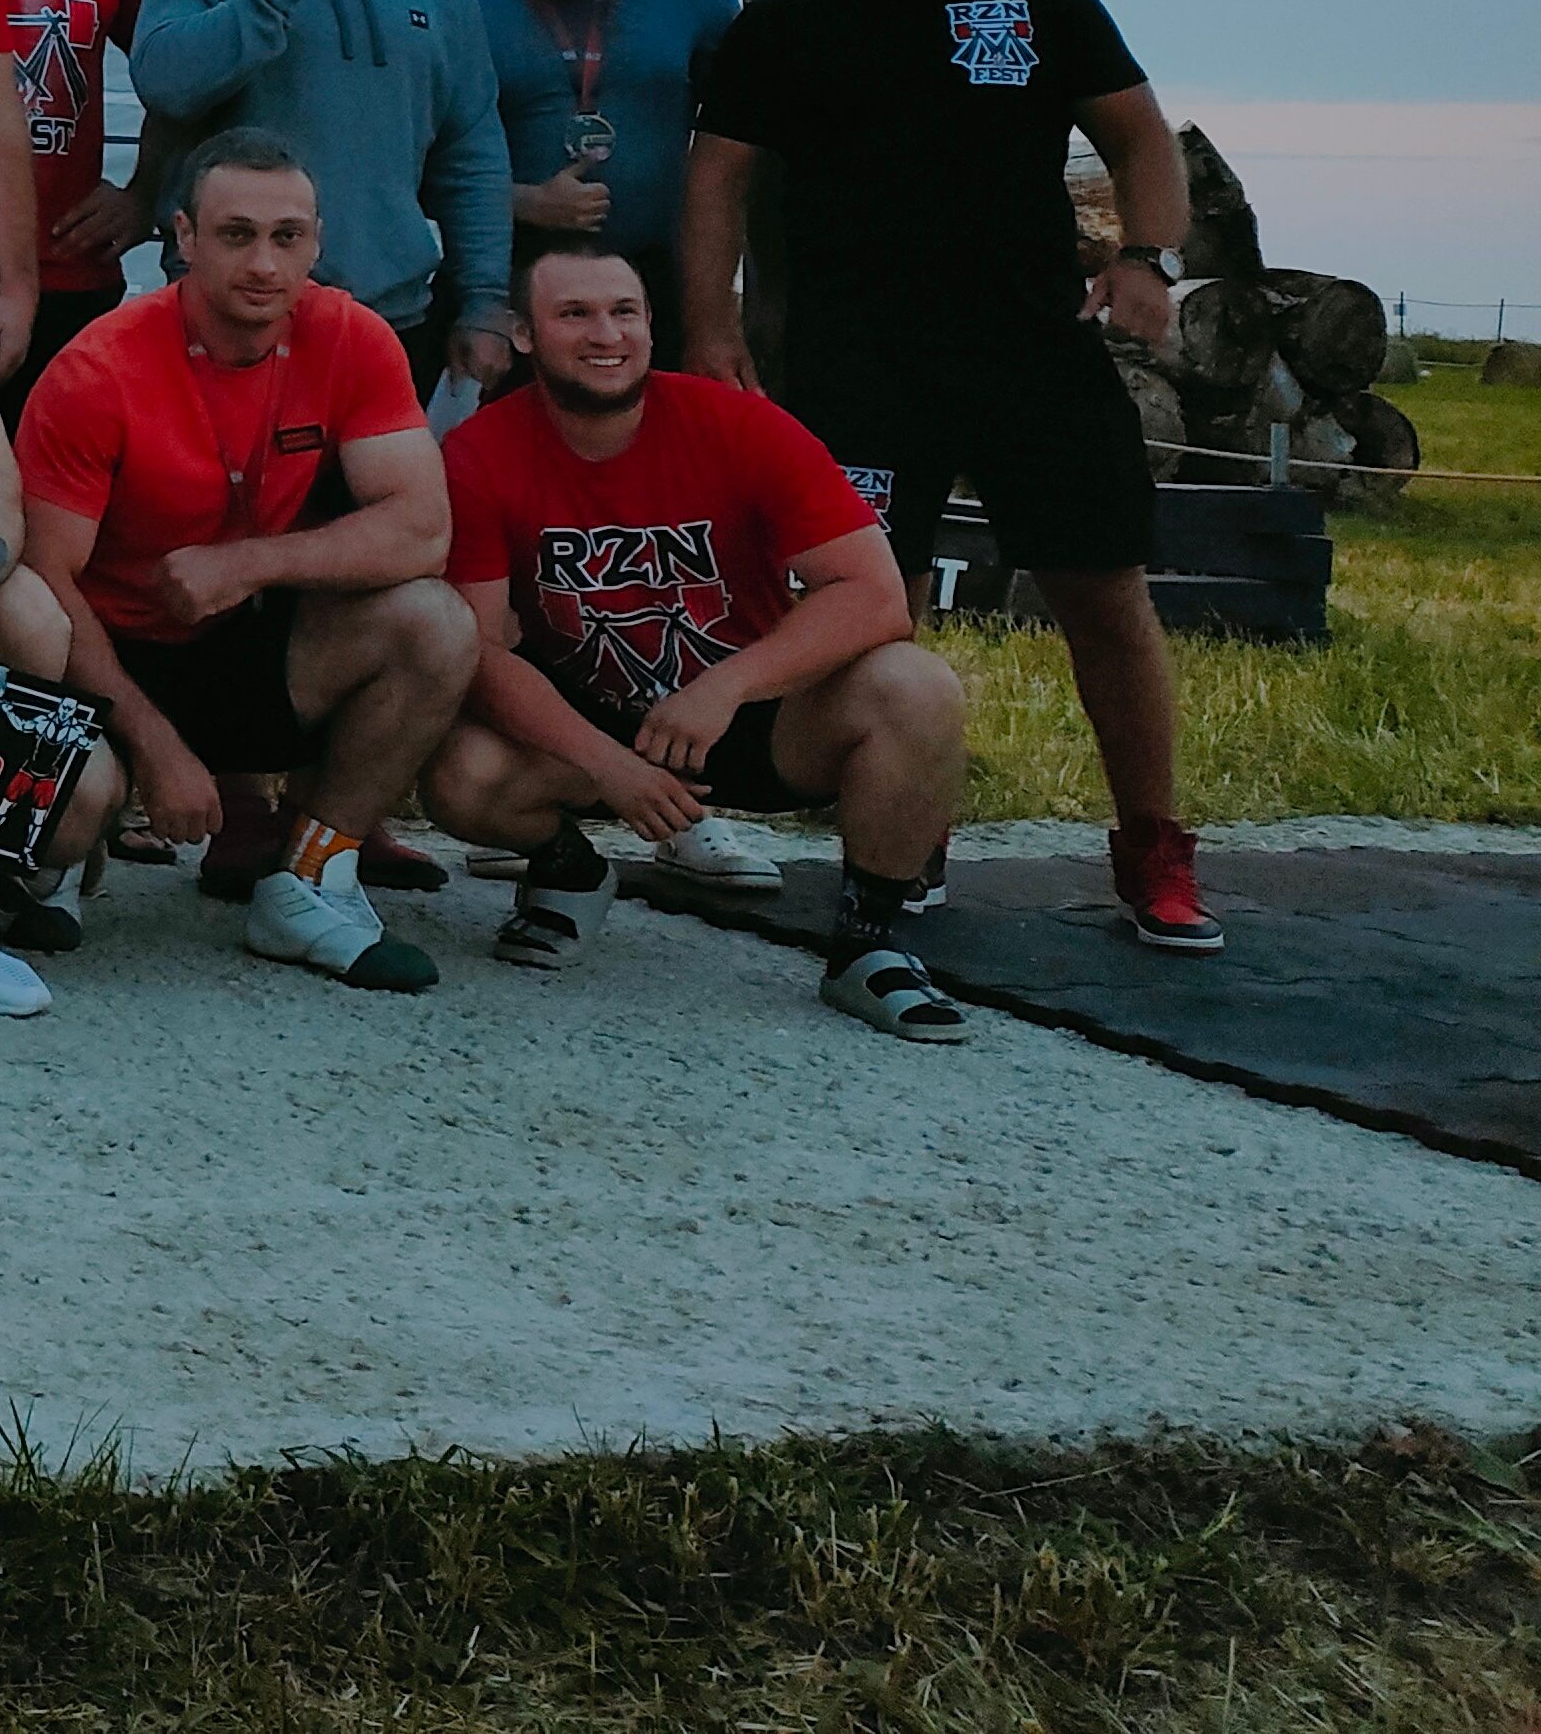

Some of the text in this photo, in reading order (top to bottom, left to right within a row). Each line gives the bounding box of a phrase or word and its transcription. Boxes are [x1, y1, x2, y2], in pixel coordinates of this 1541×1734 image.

[947, 2, 1027, 23] RZN
[972, 67, 1027, 84] FEST
[535, 519, 721, 592] RZN
